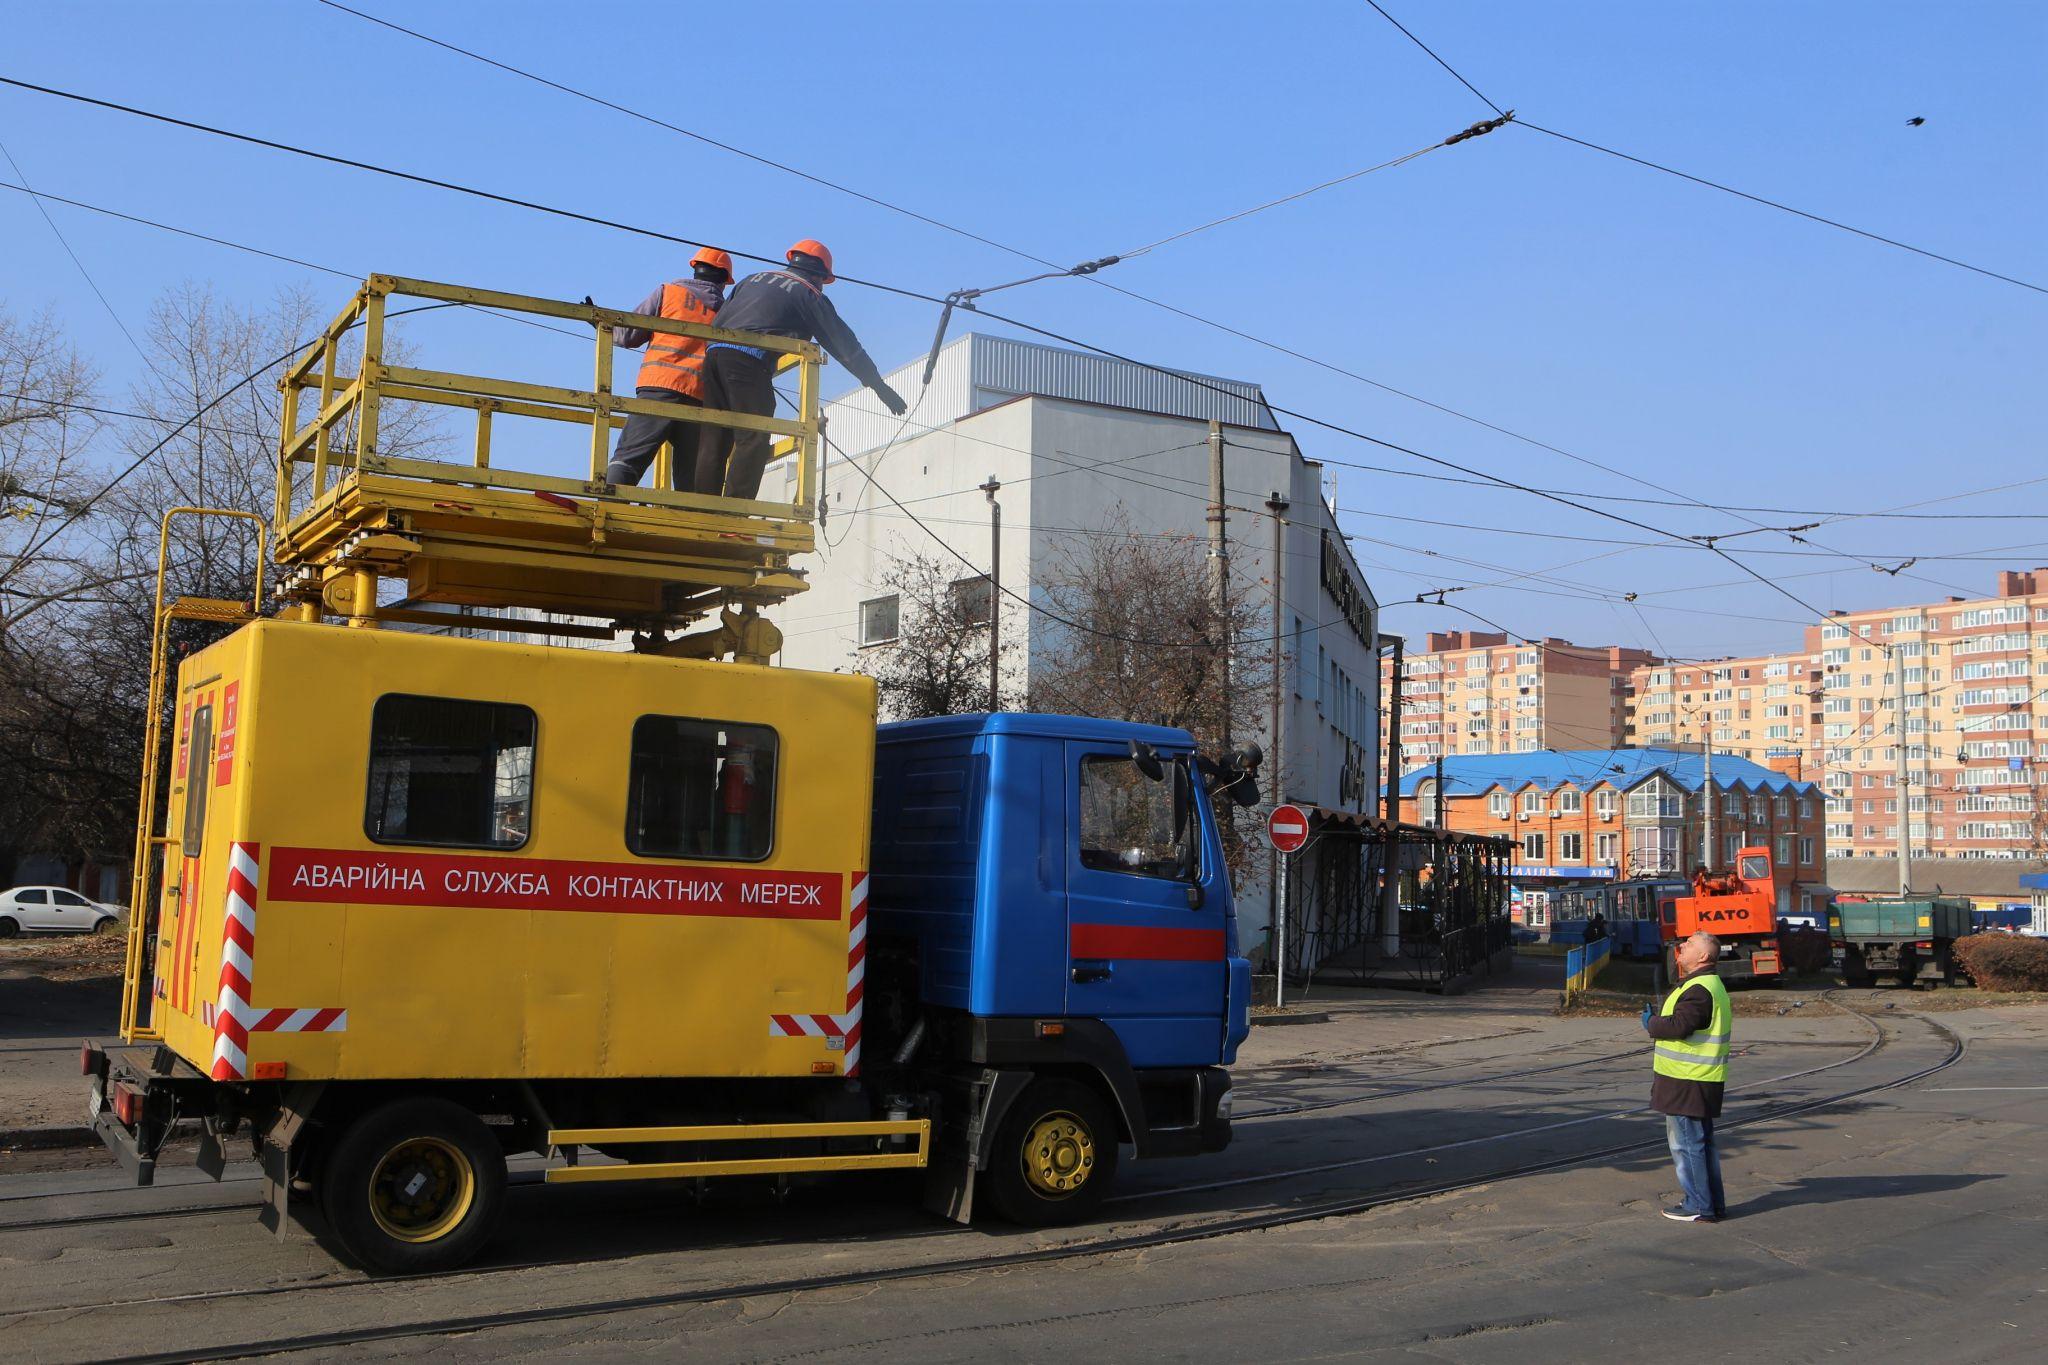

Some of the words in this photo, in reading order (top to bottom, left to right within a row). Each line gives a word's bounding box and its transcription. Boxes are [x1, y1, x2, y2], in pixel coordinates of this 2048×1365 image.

[292, 862, 426, 891] АВАРІЙНА
[443, 869, 550, 896] СЛУЖБА
[568, 875, 724, 903] КОНТАКТНИХ
[740, 882, 822, 906] МЕРЕЖ
[1698, 908, 1750, 922] KATO
